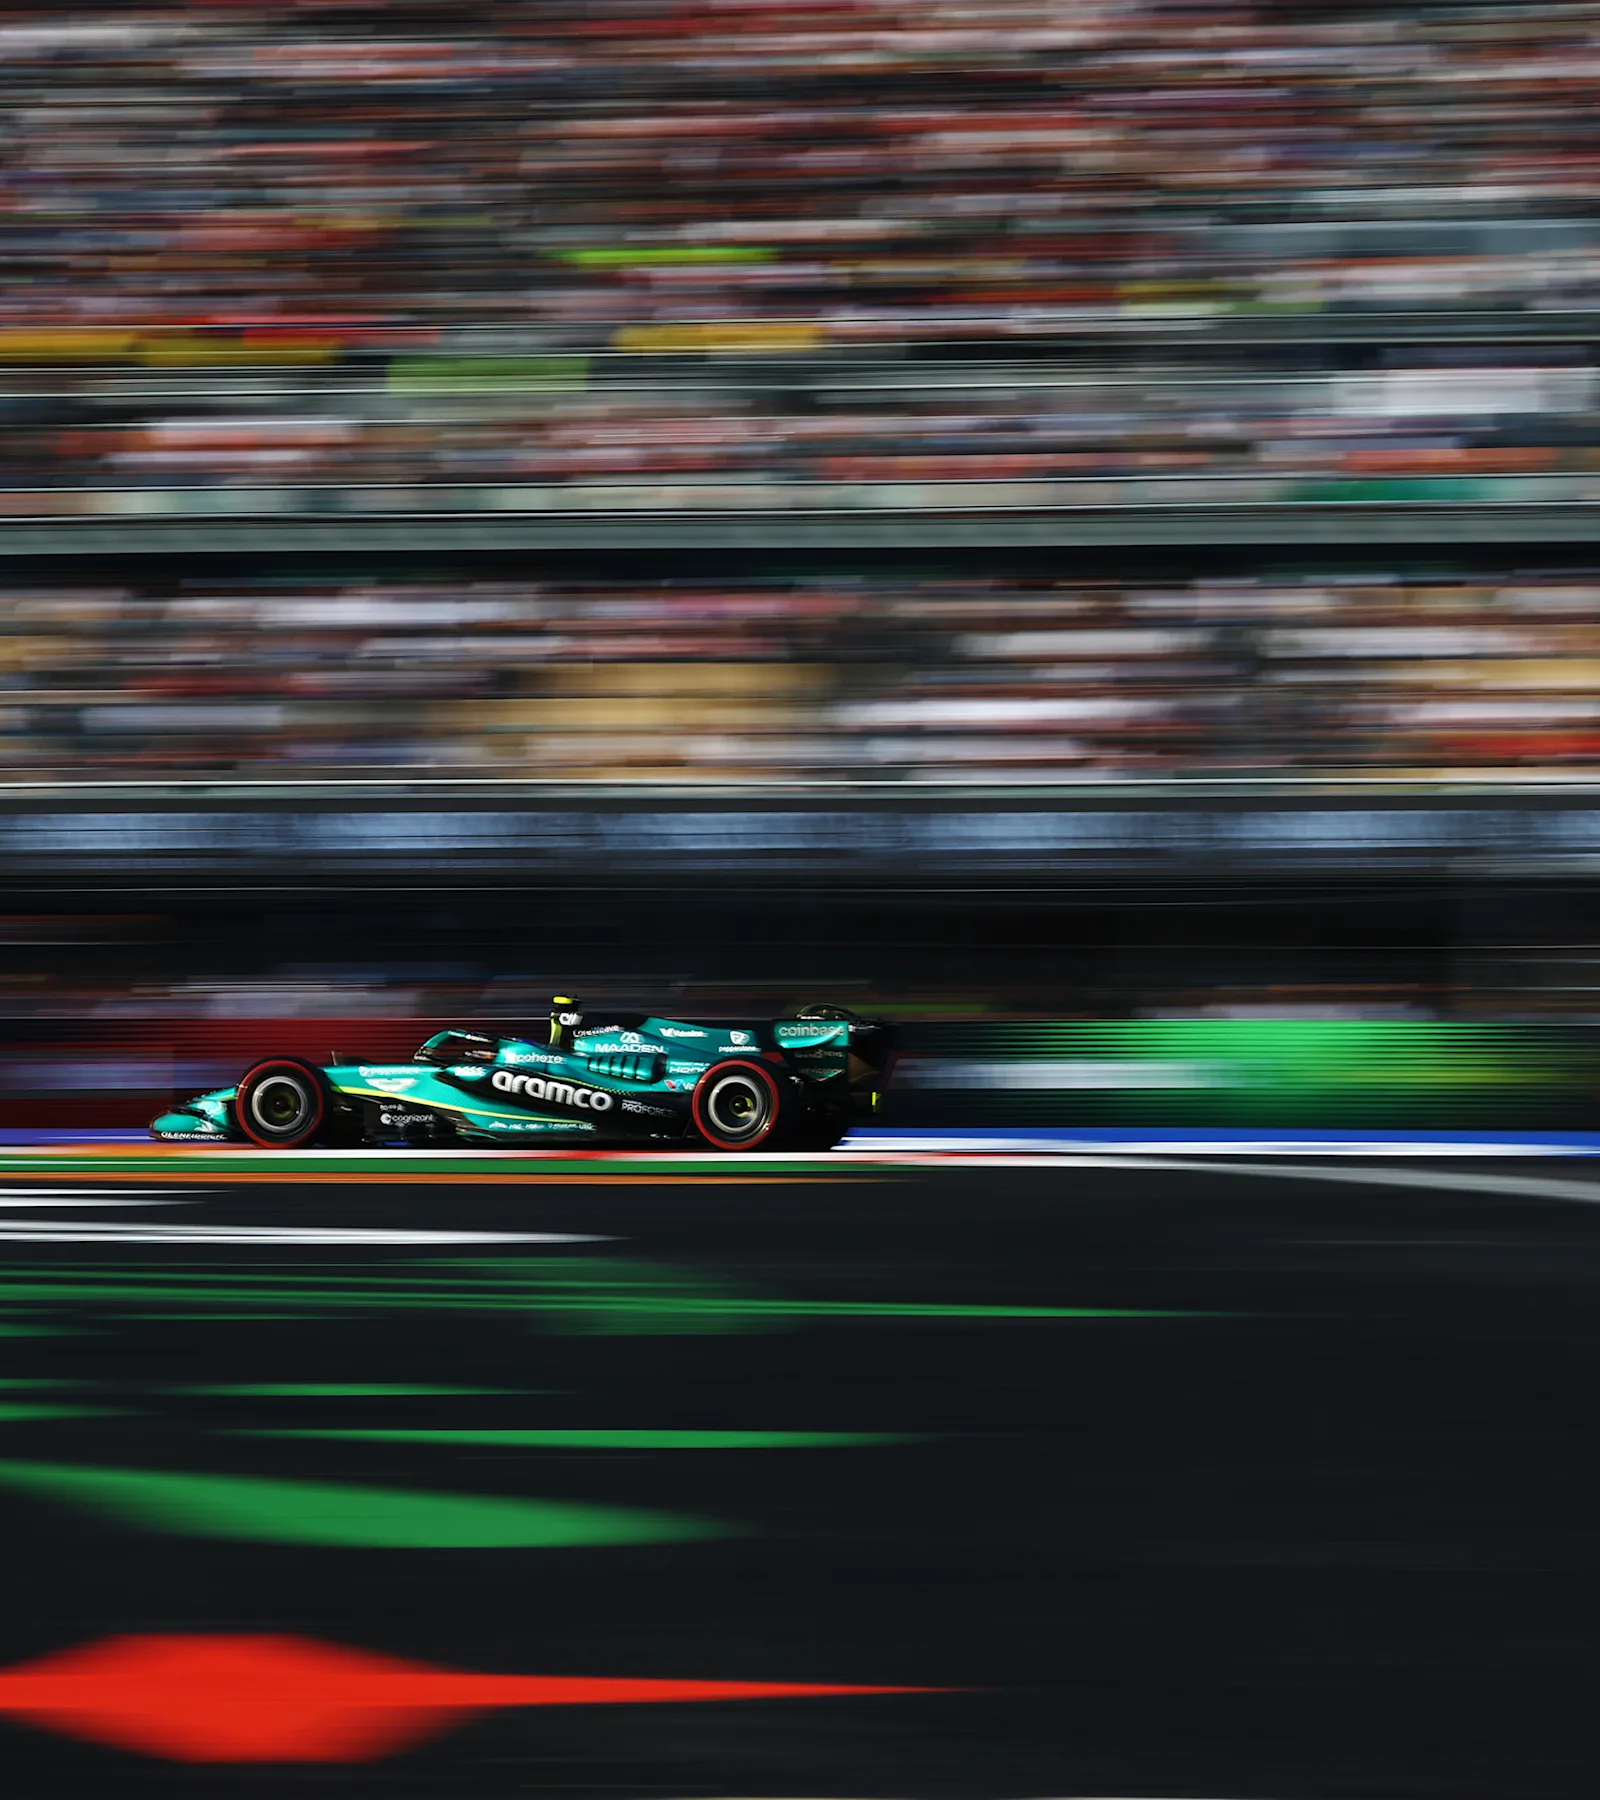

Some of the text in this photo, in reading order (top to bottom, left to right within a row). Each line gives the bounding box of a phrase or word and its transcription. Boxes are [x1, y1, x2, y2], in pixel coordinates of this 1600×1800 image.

[779, 1023, 846, 1037] coinbase
[595, 1043, 668, 1054] MAADEN
[516, 1052, 567, 1064] cohere
[492, 1071, 615, 1111] aramco
[392, 1113, 436, 1125] cognizant
